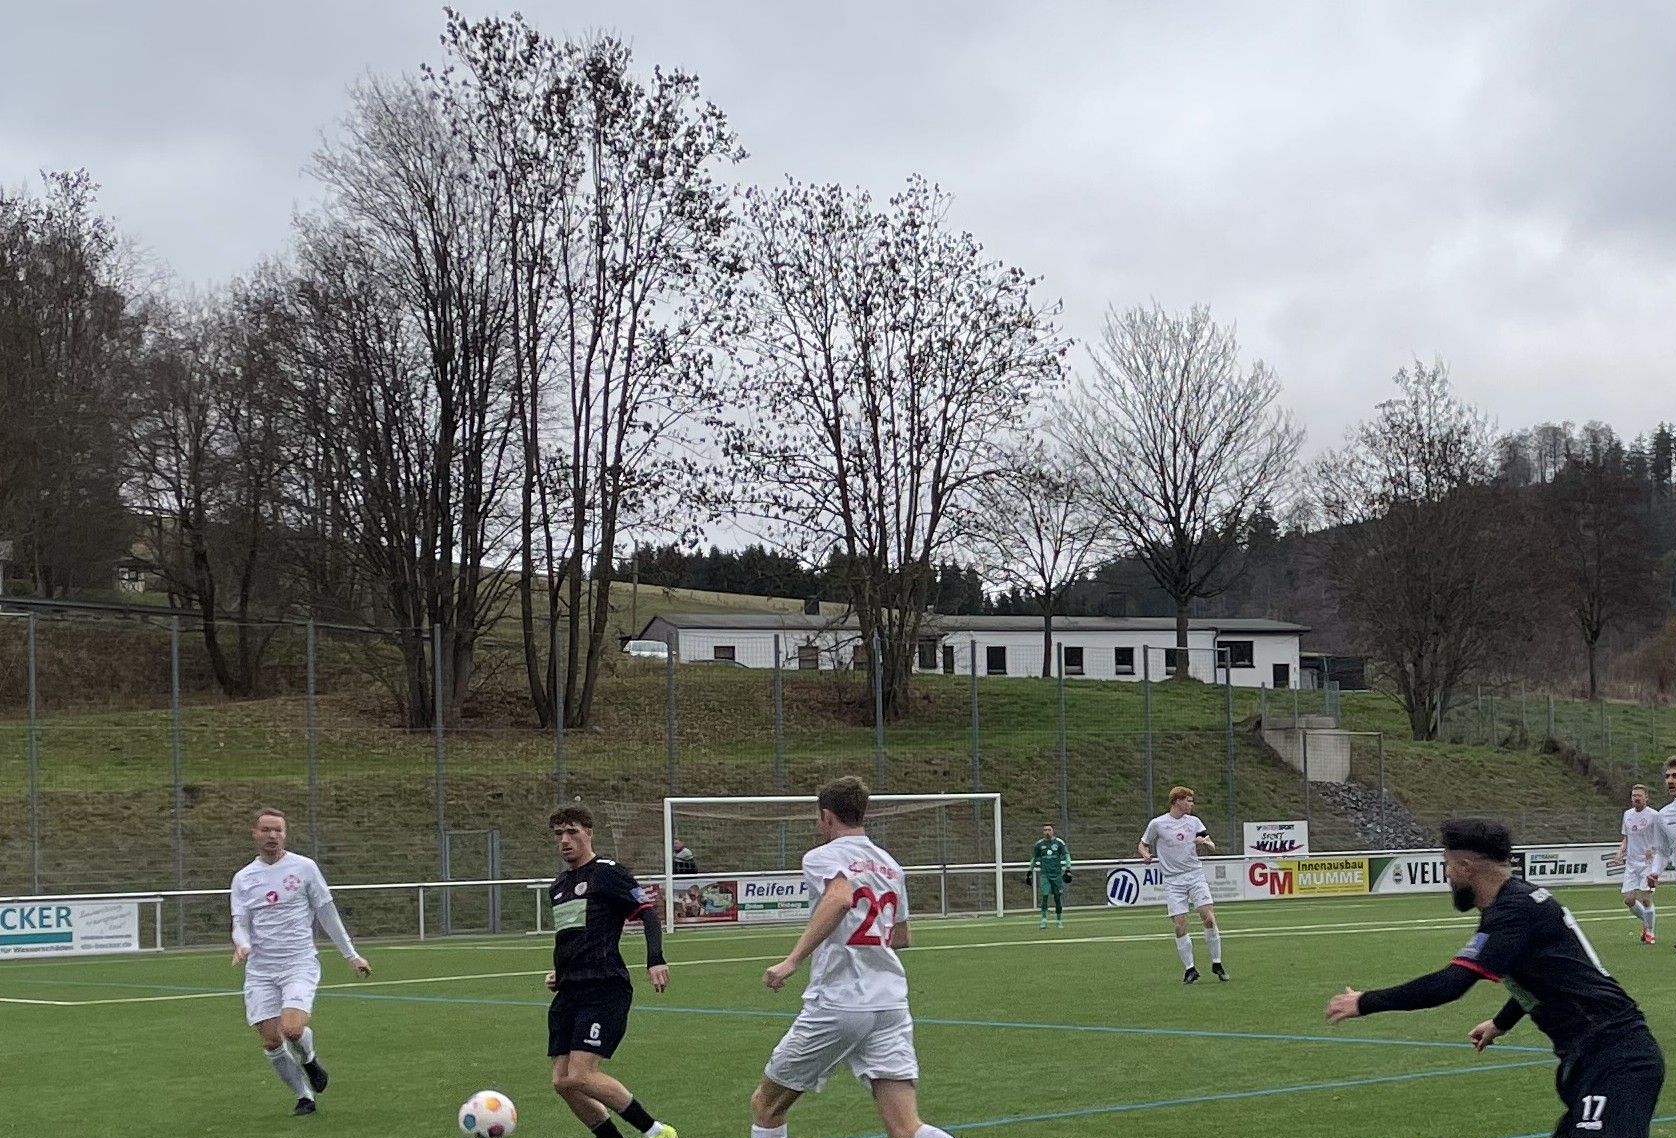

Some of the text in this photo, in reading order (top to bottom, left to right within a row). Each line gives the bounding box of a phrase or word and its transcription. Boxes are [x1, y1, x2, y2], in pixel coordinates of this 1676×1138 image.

[1256, 839, 1296, 852] WILKE
[1297, 859, 1364, 871] Innenausbau
[1298, 871, 1364, 885] MUMME
[745, 883, 794, 897] Reifen
[0, 906, 73, 931] CKER
[590, 1022, 601, 1039] 6
[1582, 1095, 1607, 1121] 17
